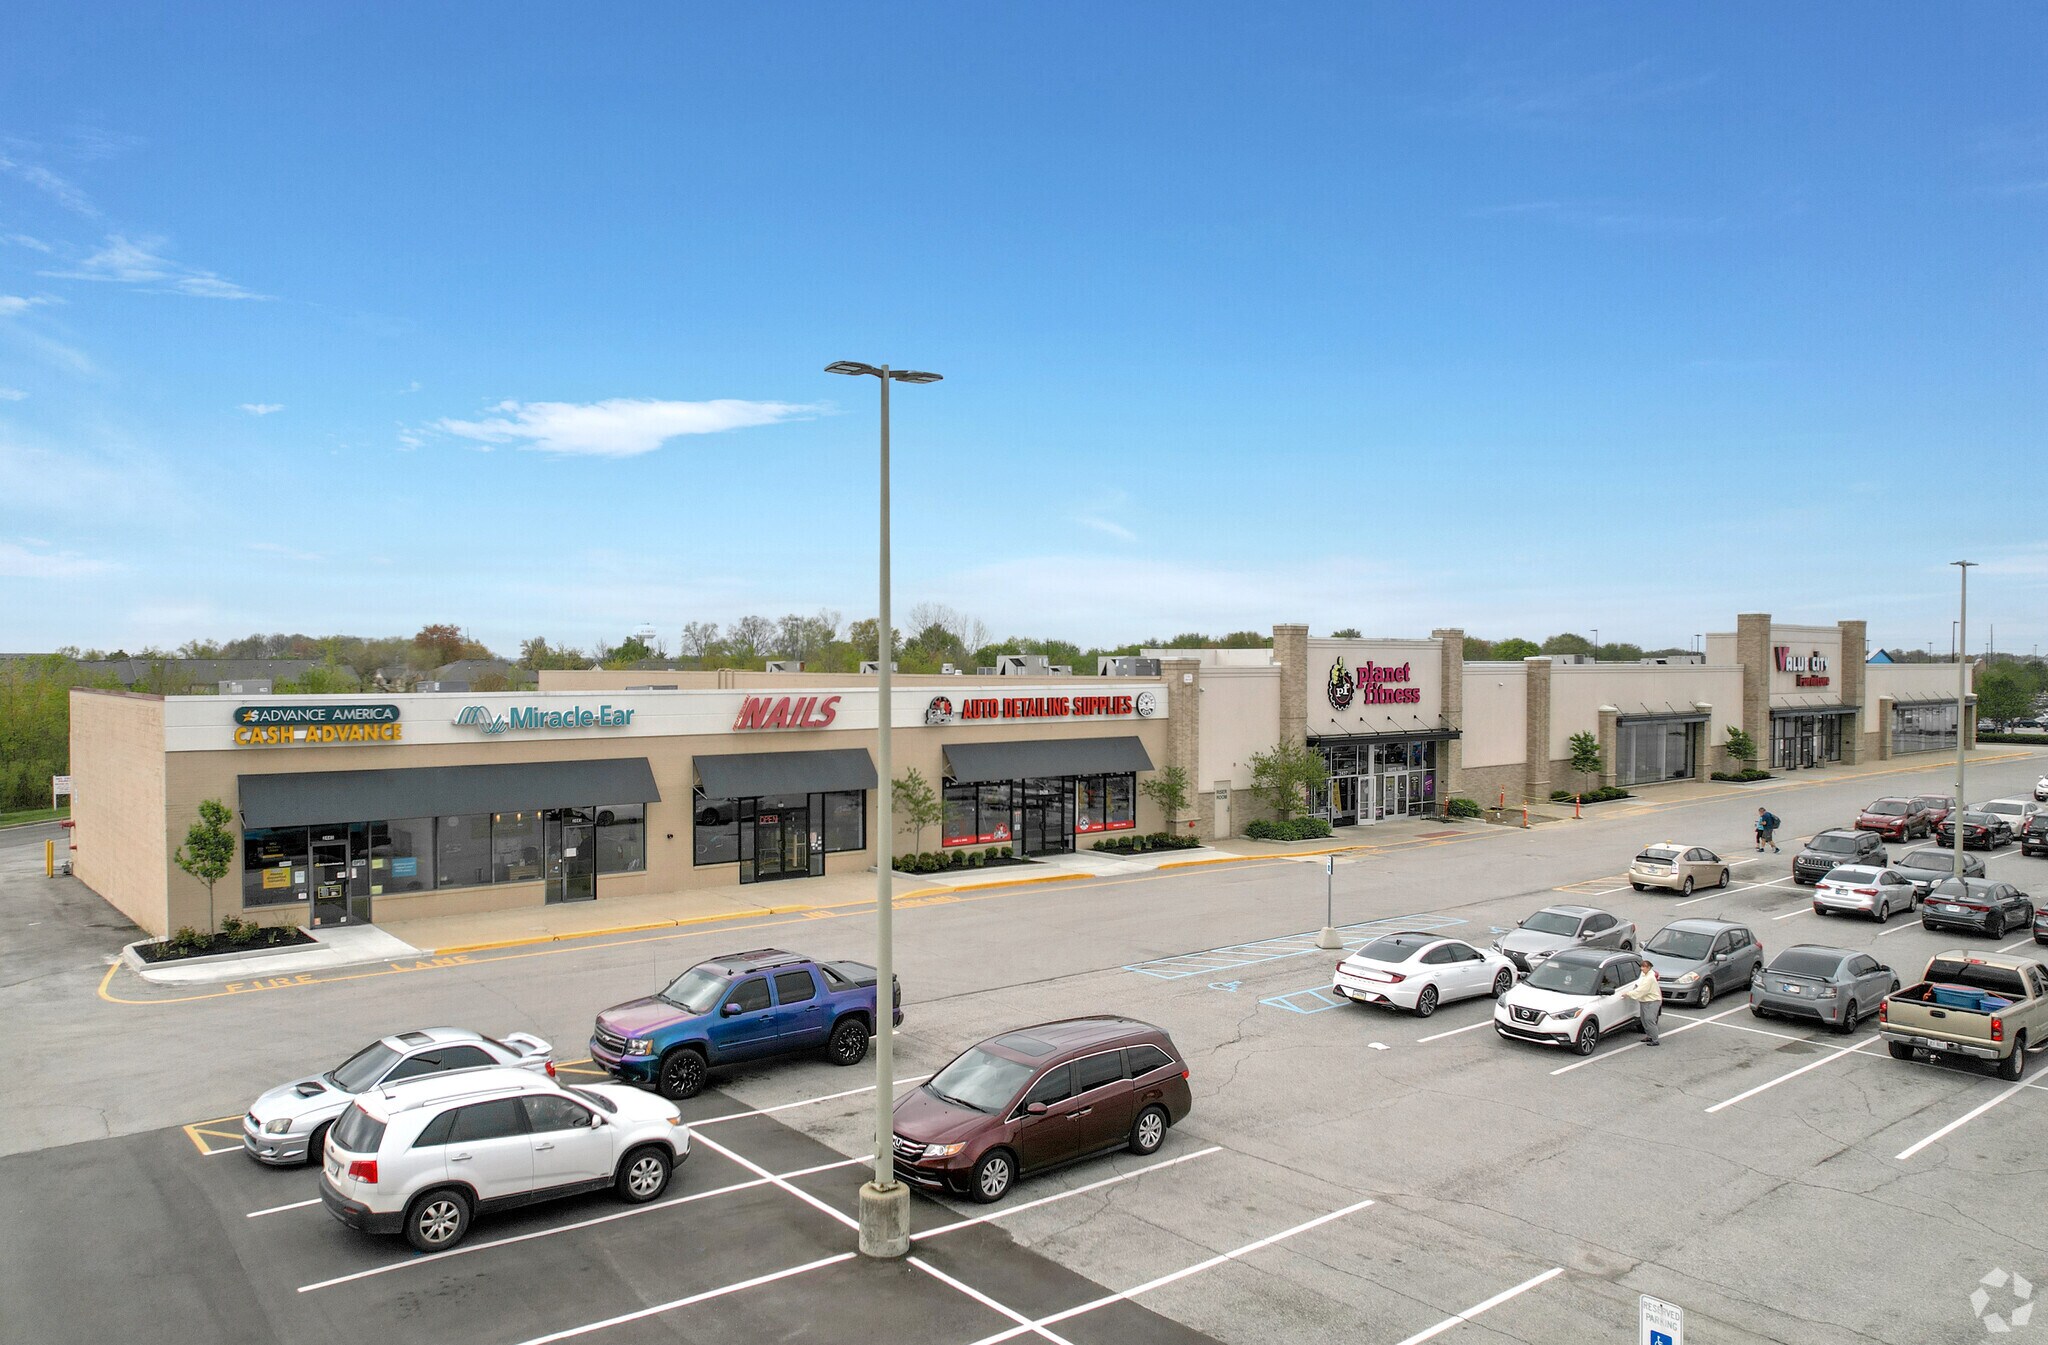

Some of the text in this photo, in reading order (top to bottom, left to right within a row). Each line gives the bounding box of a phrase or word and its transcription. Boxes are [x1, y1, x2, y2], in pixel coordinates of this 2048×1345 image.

[1356, 661, 1410, 688] planet
[1336, 684, 1350, 697] pf
[1364, 683, 1420, 704] fitness
[260, 708, 394, 722] ADVANCE AMERICA
[510, 704, 635, 728] Miracle-Ear
[738, 696, 842, 729] NAILS
[962, 699, 999, 719] AUTO
[1003, 697, 1070, 718] DETAILING
[1073, 695, 1133, 716] SUPPLIES
[234, 723, 403, 746] CASH ADVANCE
[759, 815, 778, 824] OPEN
[225, 955, 473, 992] FIRE LANE
[1643, 1301, 1680, 1321] RESERVED
[1645, 1312, 1678, 1331] PARKING
